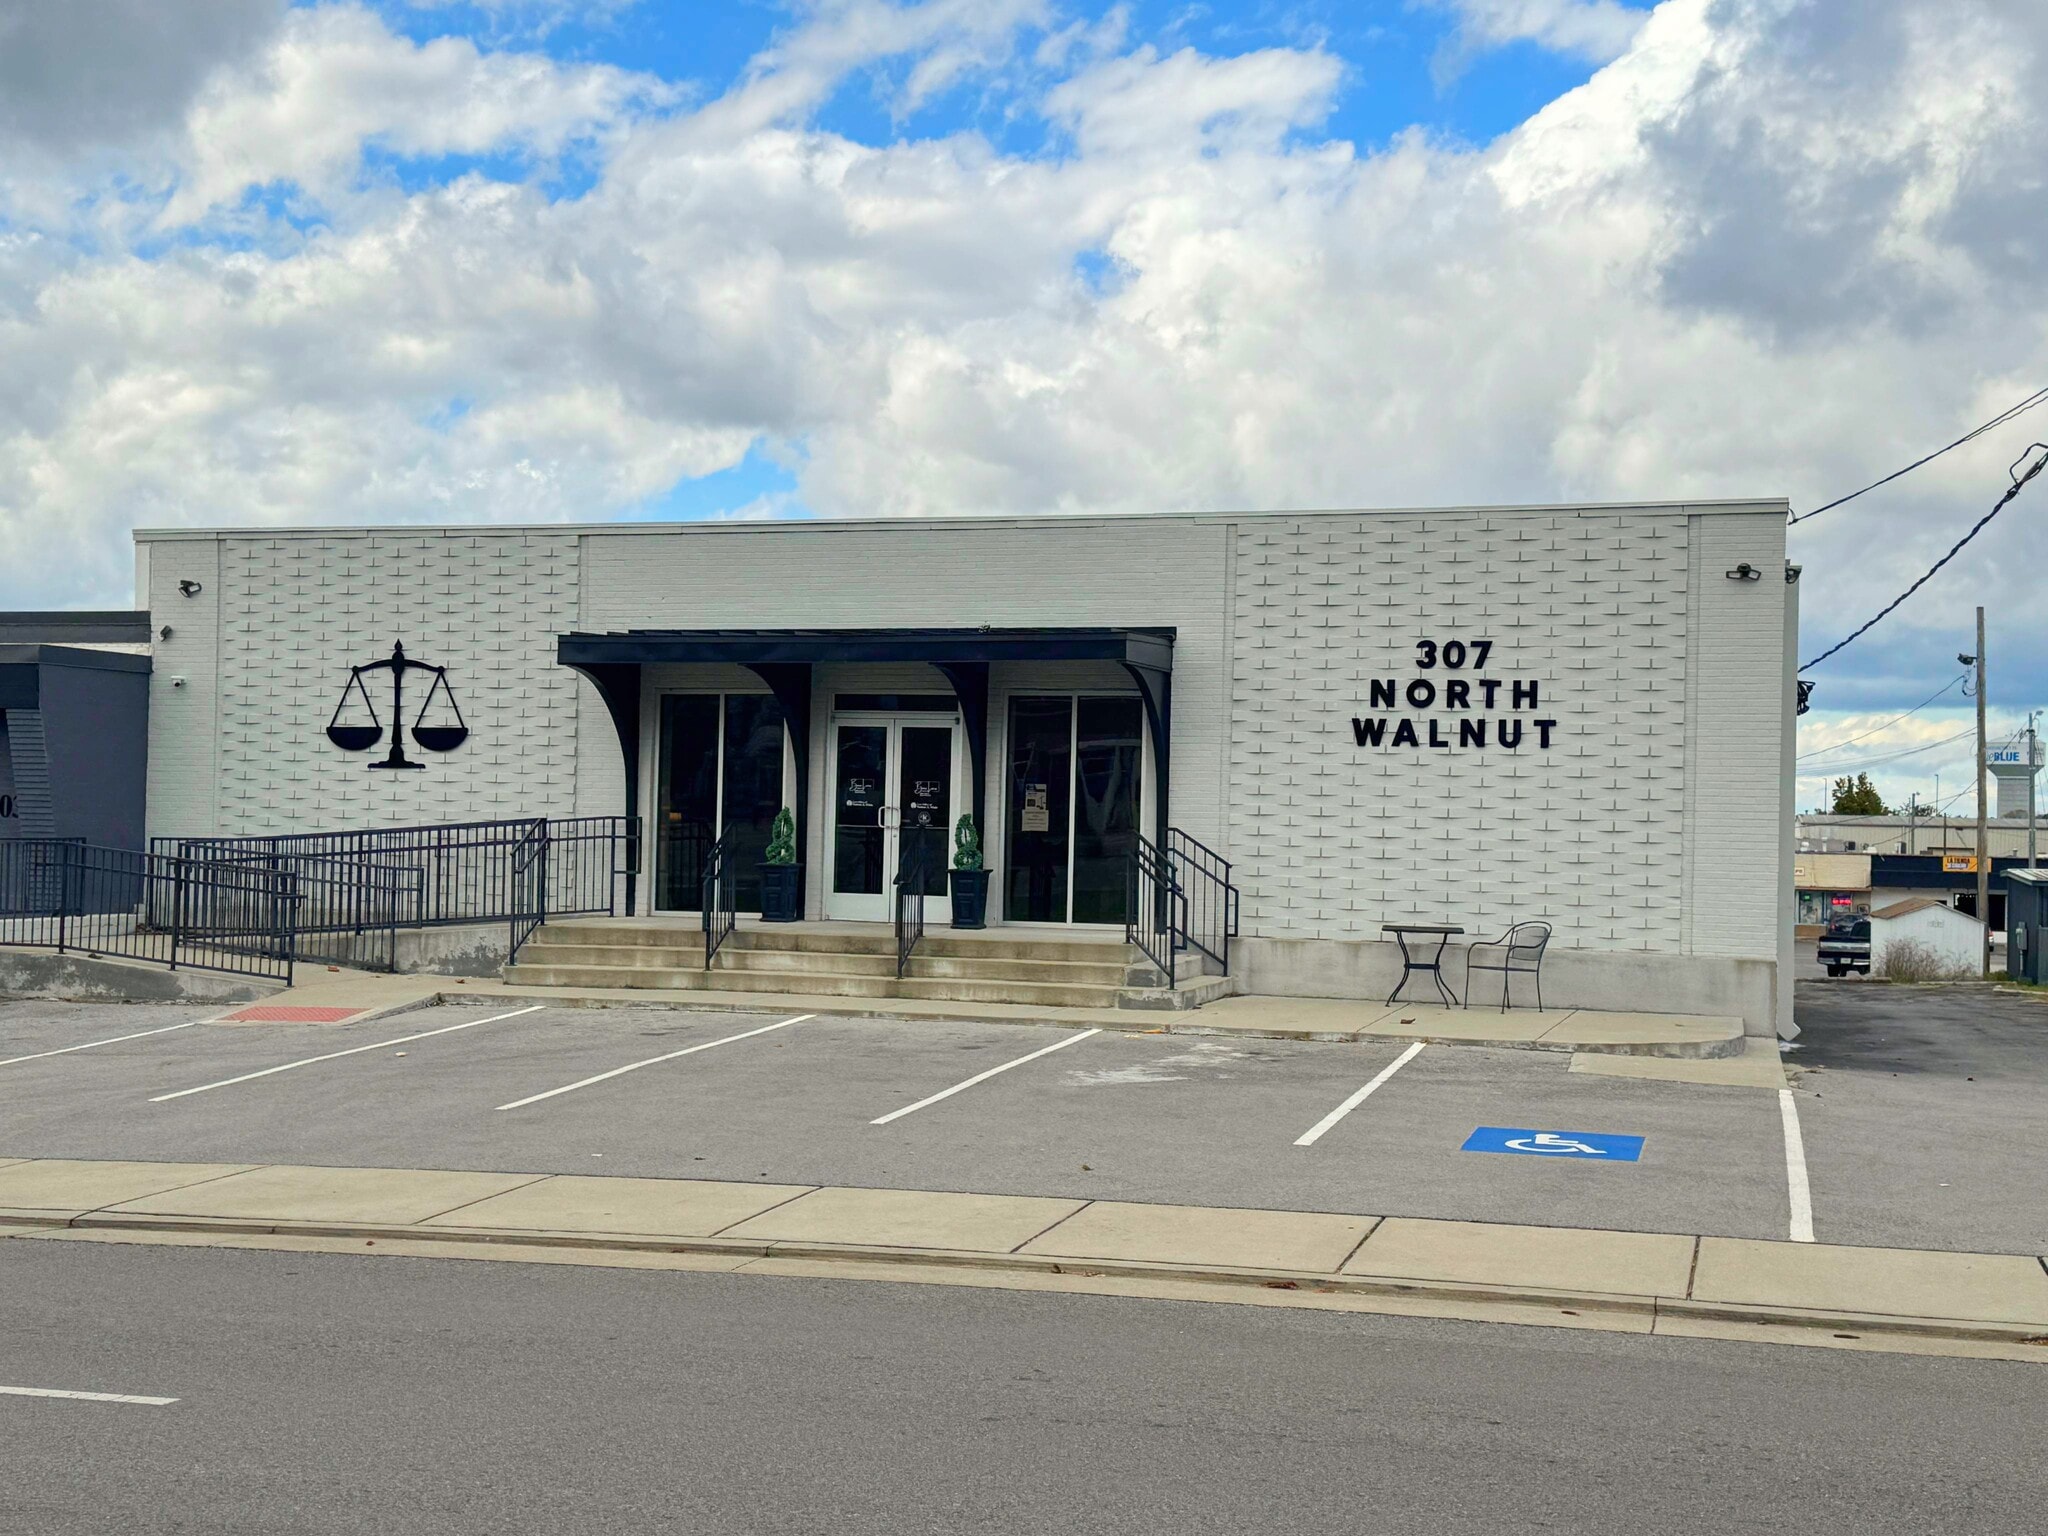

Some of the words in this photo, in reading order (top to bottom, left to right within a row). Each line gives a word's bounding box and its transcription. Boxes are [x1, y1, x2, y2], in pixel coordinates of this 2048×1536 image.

[1415, 639, 1493, 669] 307
[1370, 678, 1539, 709] NORTH
[1351, 717, 1557, 749] WALNUT
